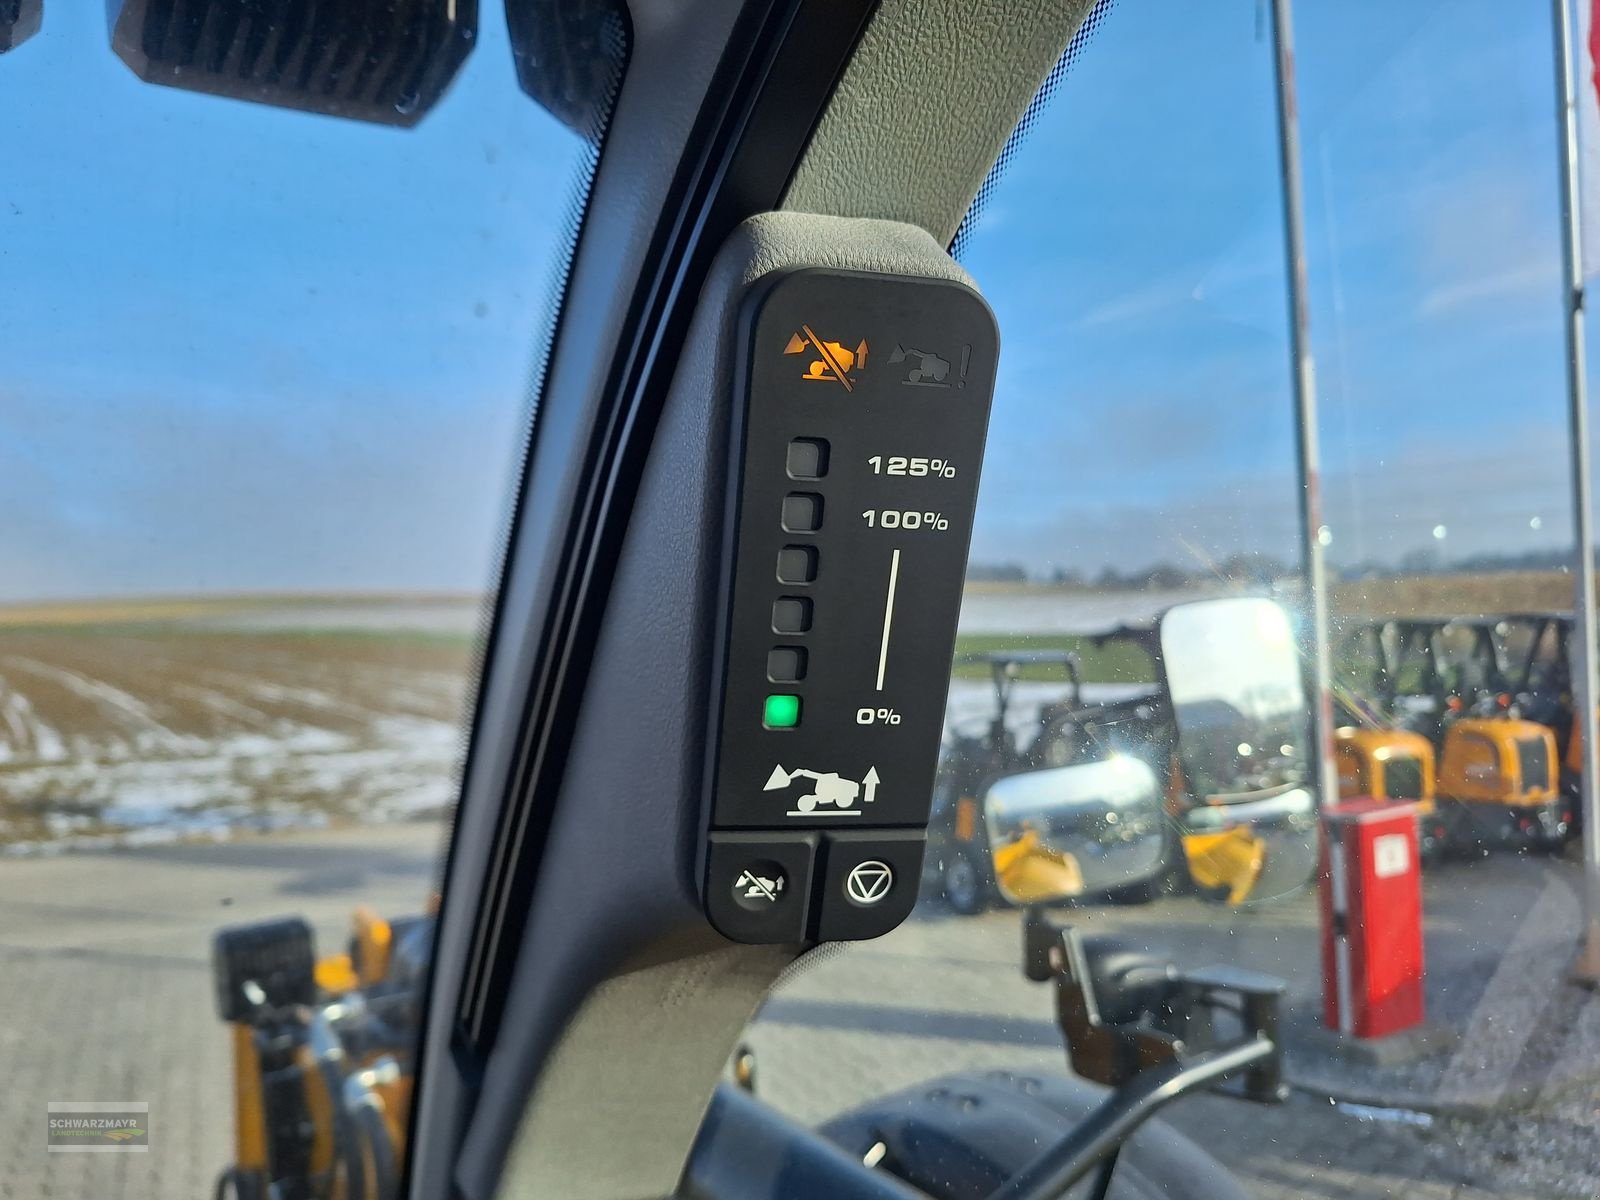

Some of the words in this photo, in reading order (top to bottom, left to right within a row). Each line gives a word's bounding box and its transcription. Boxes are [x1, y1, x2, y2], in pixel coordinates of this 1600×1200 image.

[867, 455, 956, 478] 125%
[862, 510, 949, 531] 100%
[856, 708, 901, 725] 0%
